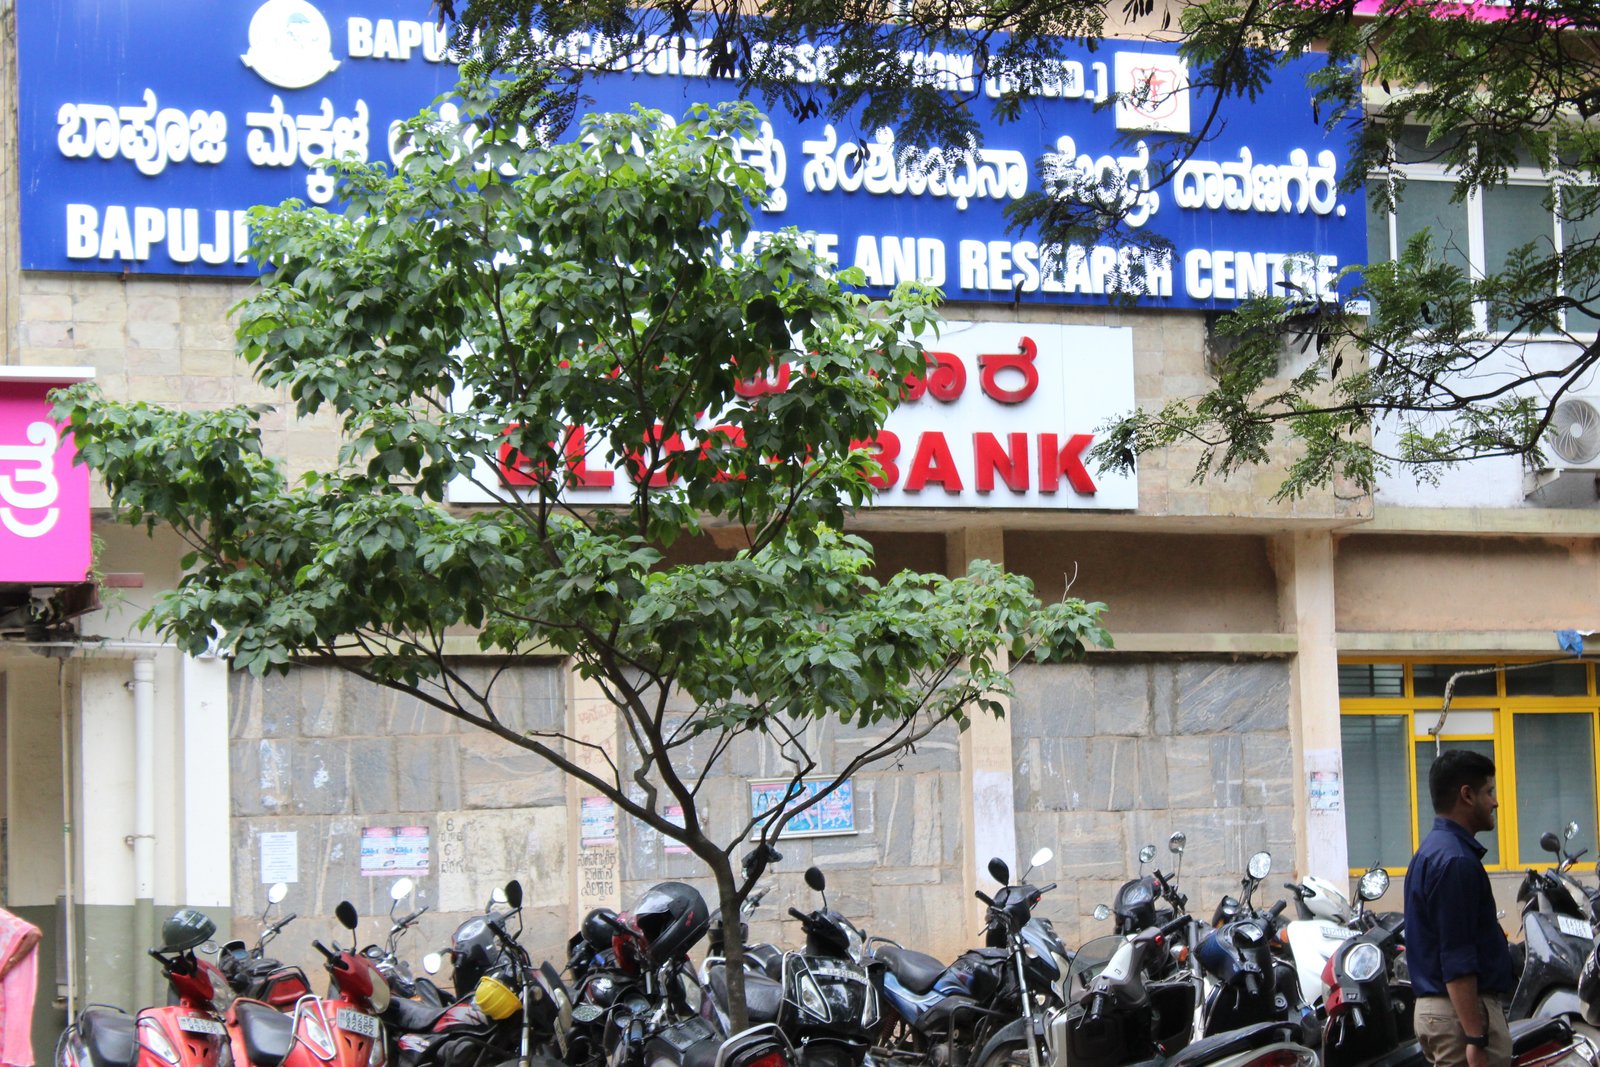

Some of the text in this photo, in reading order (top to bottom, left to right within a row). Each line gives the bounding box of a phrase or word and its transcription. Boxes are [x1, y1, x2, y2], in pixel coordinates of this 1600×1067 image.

[751, 42, 975, 92] ASSOTION
[57, 88, 227, 175] ಬಾಪೂಜಿ
[246, 94, 369, 204] ಮಕ್ಕಳ
[802, 123, 1028, 211] ಸಂಶೋಧನಾ
[1173, 146, 1347, 217] ದಾವಣಗೆರೆ.
[66, 203, 249, 264] BAPUJI
[853, 235, 946, 287] AND
[959, 239, 1173, 297] RESEARCH
[1185, 248, 1339, 303] CENTRE
[498, 423, 1099, 495] BLO BANK
